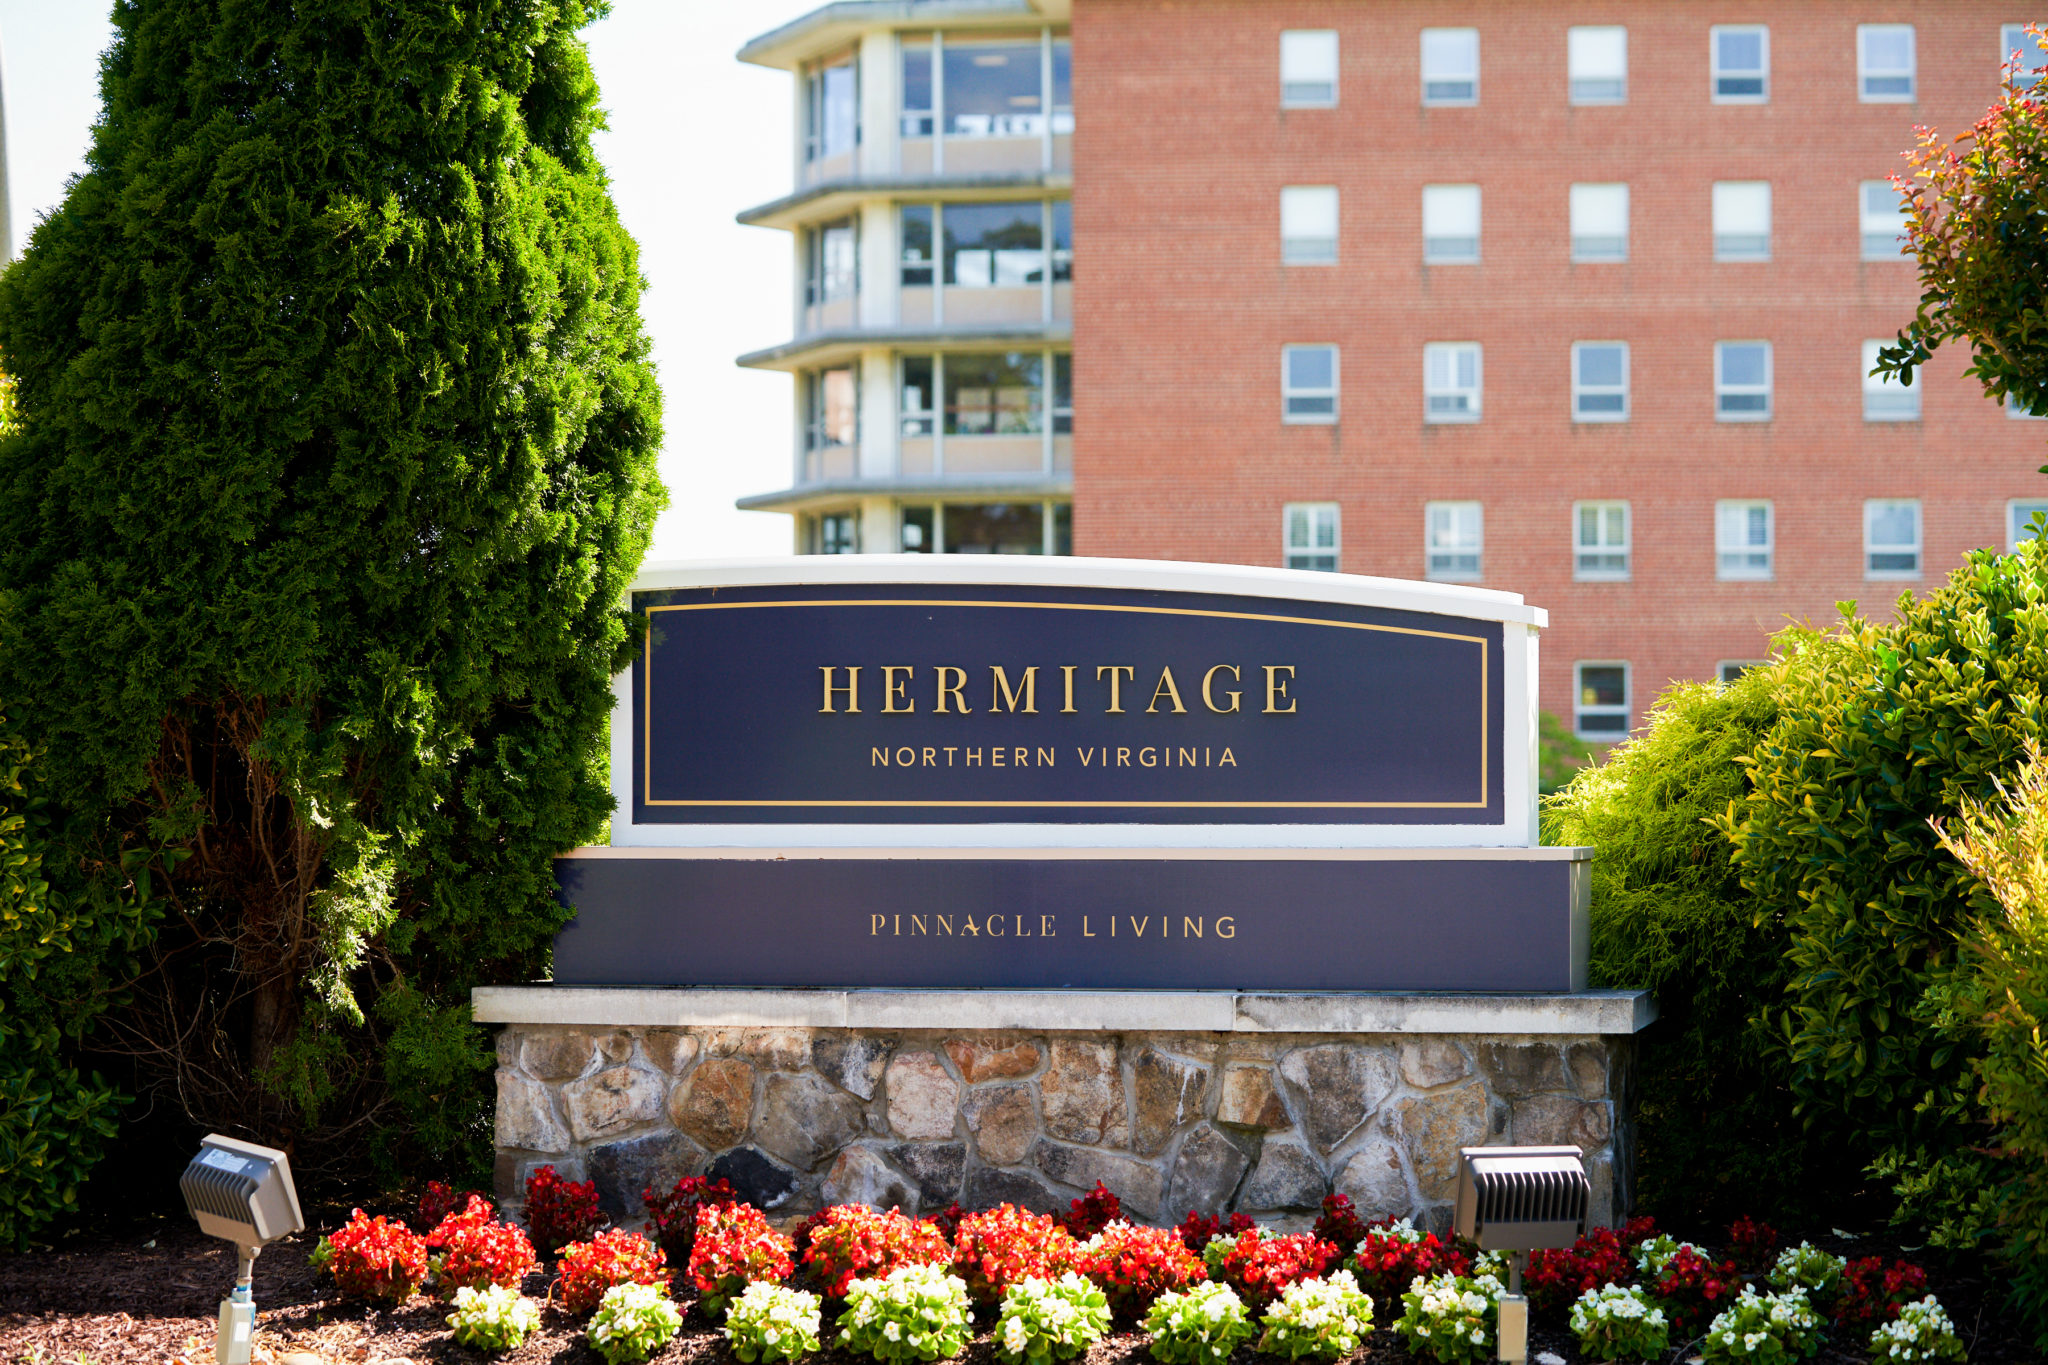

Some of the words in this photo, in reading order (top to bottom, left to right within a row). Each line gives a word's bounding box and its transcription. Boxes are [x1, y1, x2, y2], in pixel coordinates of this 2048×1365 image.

[819, 665, 1297, 713] HERMITAGE
[870, 747, 1058, 767] NORTHERN
[1077, 747, 1238, 767] VIRGINIA
[870, 913, 1056, 937] PINNACLE
[1083, 915, 1236, 939] LIVING
